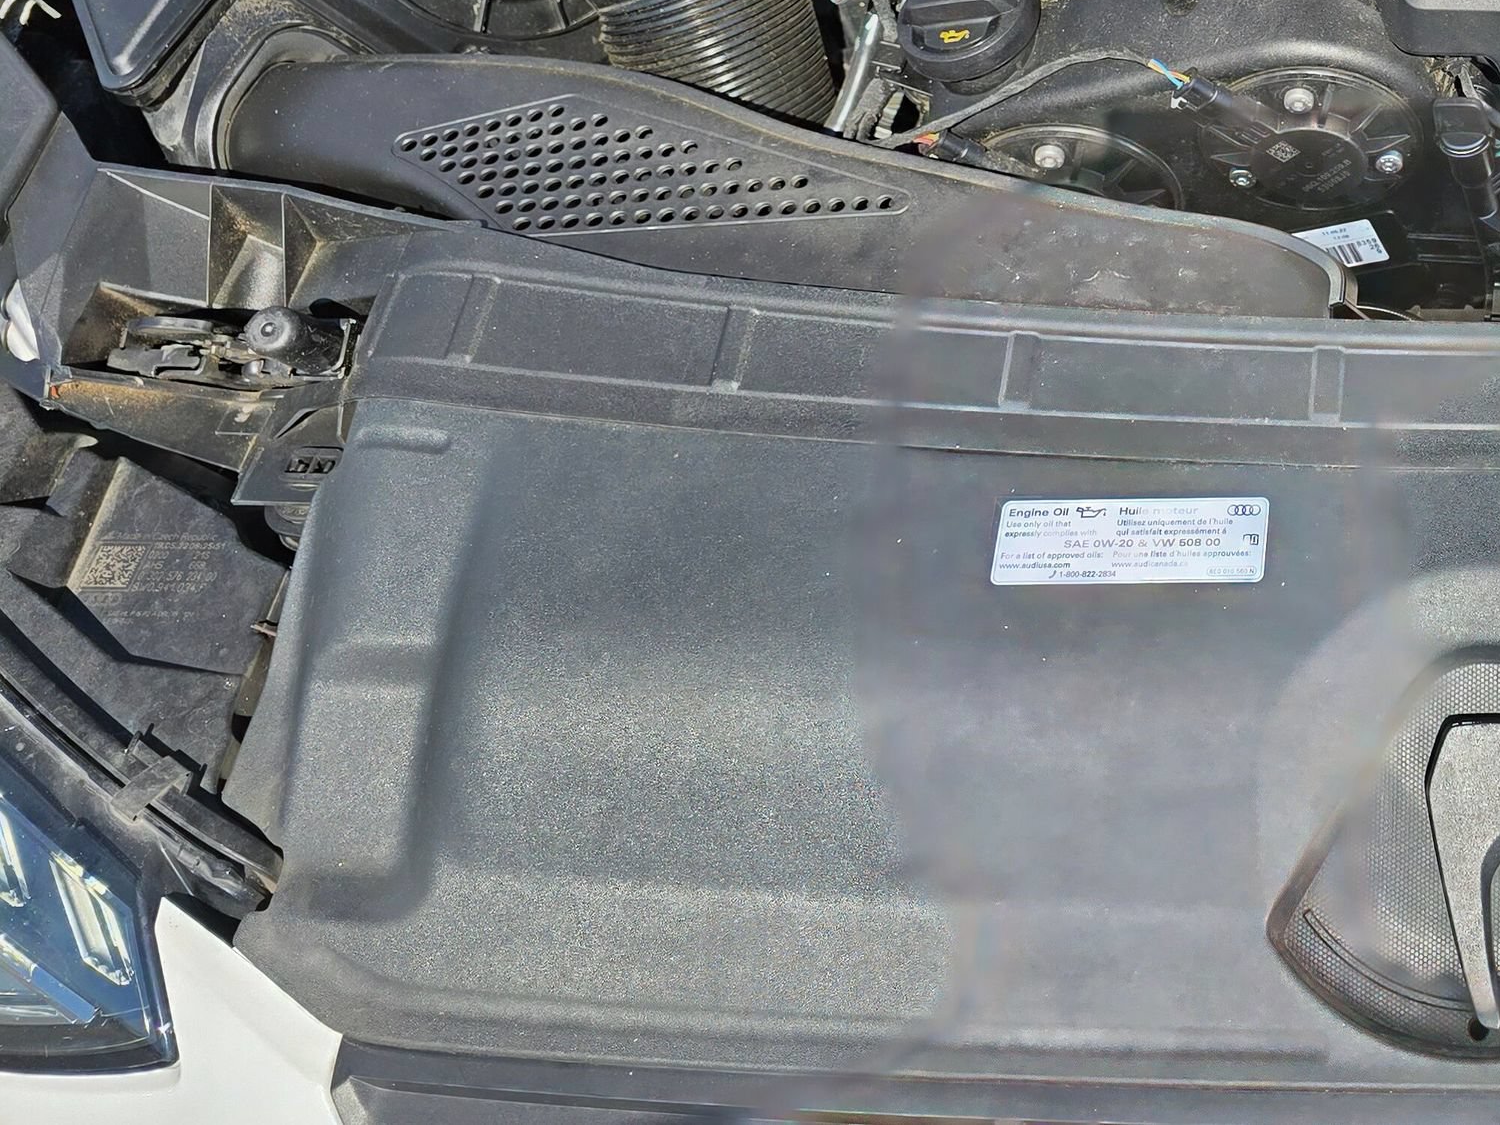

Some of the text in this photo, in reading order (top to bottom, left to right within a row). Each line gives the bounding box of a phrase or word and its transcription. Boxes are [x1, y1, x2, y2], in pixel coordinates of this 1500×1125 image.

[1008, 507, 1069, 518] Engine Oil
[1006, 519, 1071, 528] Use only oil that
[1116, 518, 1146, 526] Utilisez
[1147, 518, 1195, 526] uniquement
[1004, 530, 1041, 538] expressly
[1115, 528, 1129, 536] qui
[1064, 538, 1221, 548] SAE 0W-20 & VW 508 00
[1036, 551, 1046, 559] of
[1046, 551, 1085, 560] approved
[1112, 550, 1131, 558] Pour
[1059, 570, 1116, 578] 1-800-822-2834
